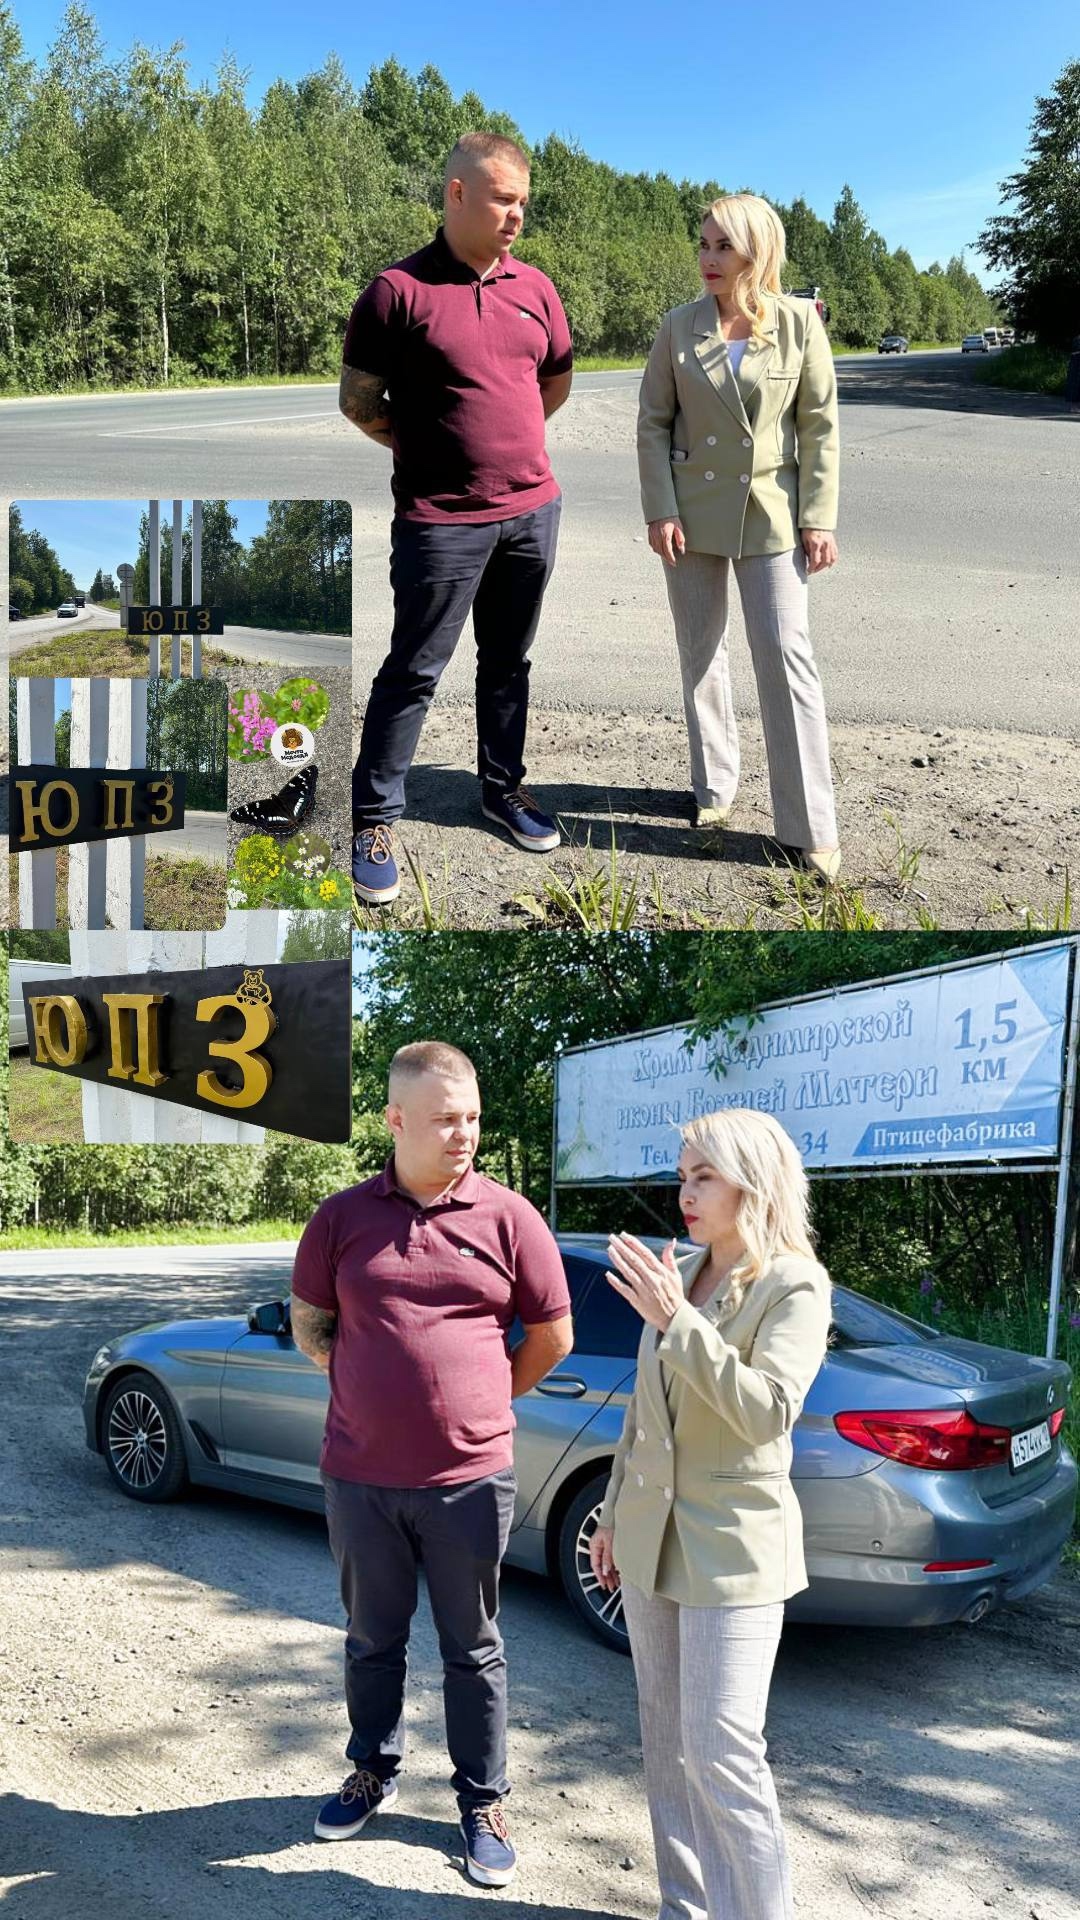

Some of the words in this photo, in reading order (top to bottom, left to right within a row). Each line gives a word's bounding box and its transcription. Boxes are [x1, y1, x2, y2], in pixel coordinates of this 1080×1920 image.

[954, 999, 1018, 1053] 1,5
[633, 1045, 692, 1089] Храм
[616, 1100, 680, 1130] иконы
[685, 1078, 787, 1119] Божией
[793, 1066, 939, 1112] Матери
[640, 1144, 673, 1166] Тел.
[873, 1119, 1037, 1149] Птицефабрика
